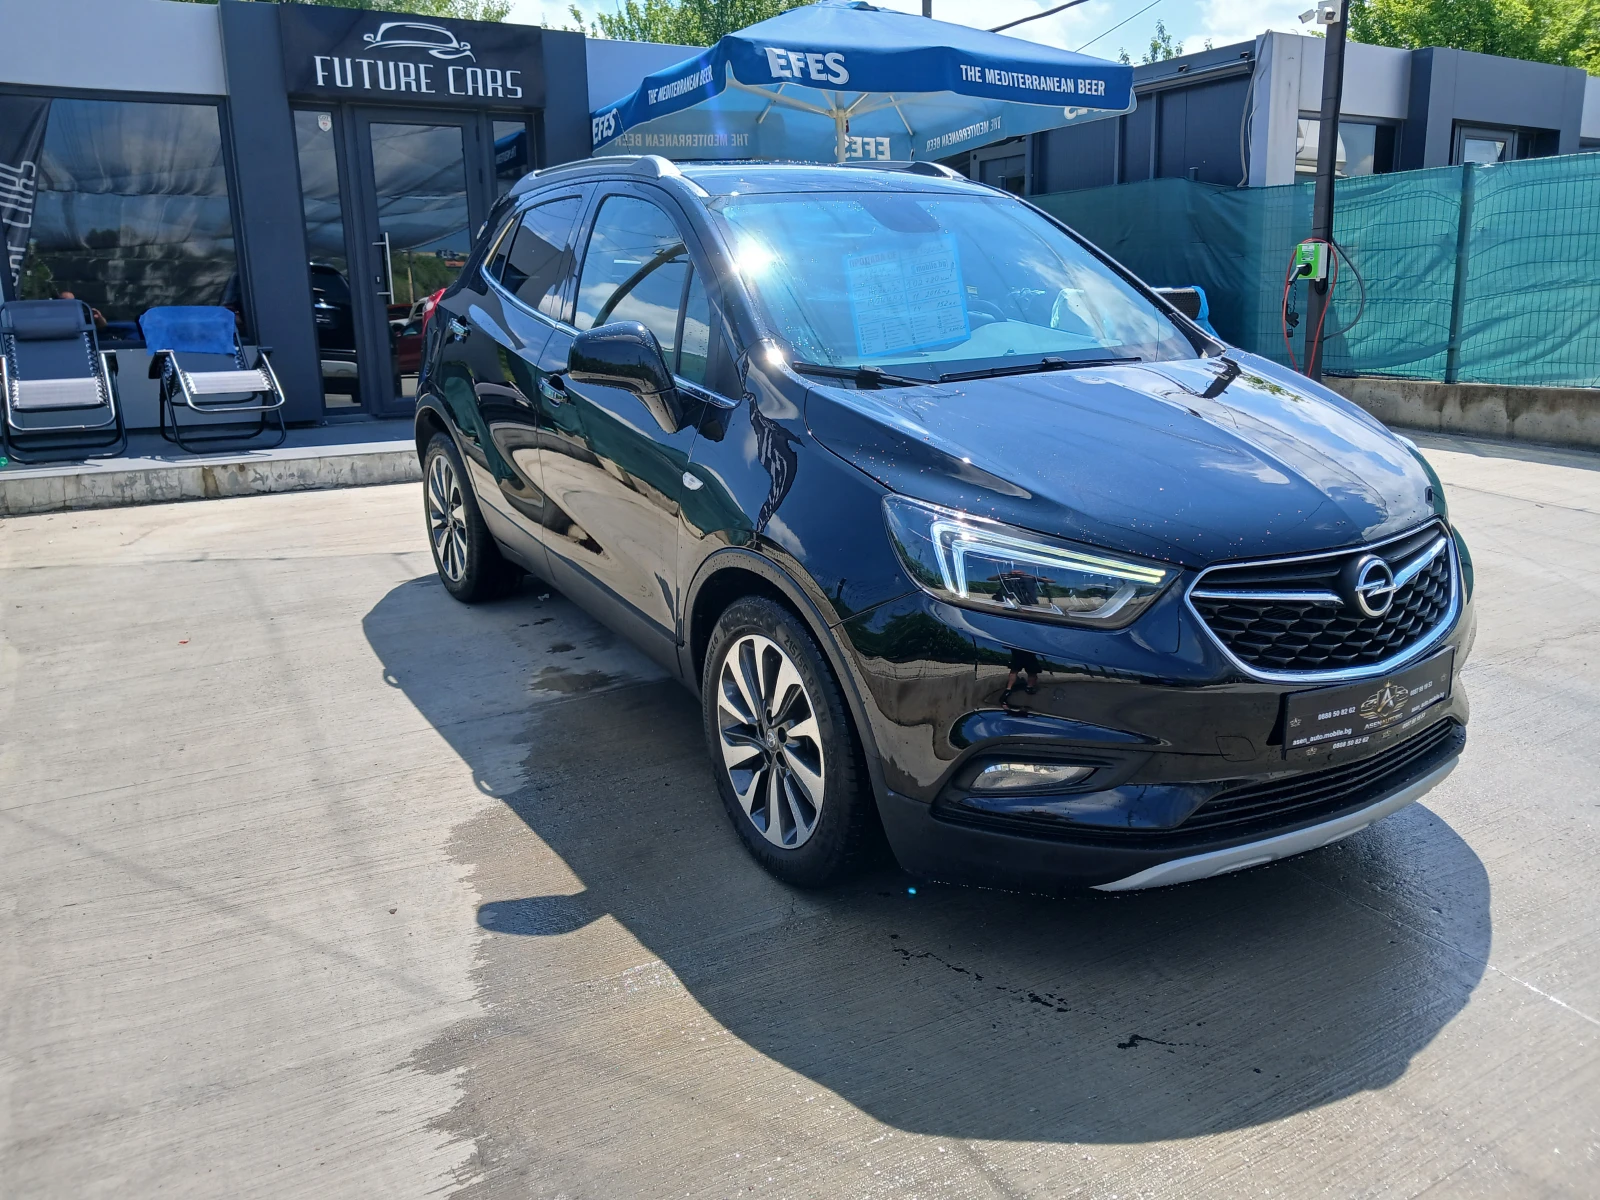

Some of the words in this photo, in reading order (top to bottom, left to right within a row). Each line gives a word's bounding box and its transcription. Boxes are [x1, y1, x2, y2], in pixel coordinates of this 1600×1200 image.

[314, 55, 436, 93] FUTURE
[447, 66, 523, 99] CARS
[648, 89, 657, 105] THE
[658, 71, 699, 102] MEDITERRANEAN
[699, 64, 713, 86] BEER
[764, 47, 850, 85] EFES
[960, 64, 982, 83] THE
[985, 68, 1075, 94] MEDITERRANEAN
[1078, 79, 1106, 97] BEER
[592, 109, 617, 145] EFES
[1292, 728, 1352, 745] asen_auto.mobile.bg
